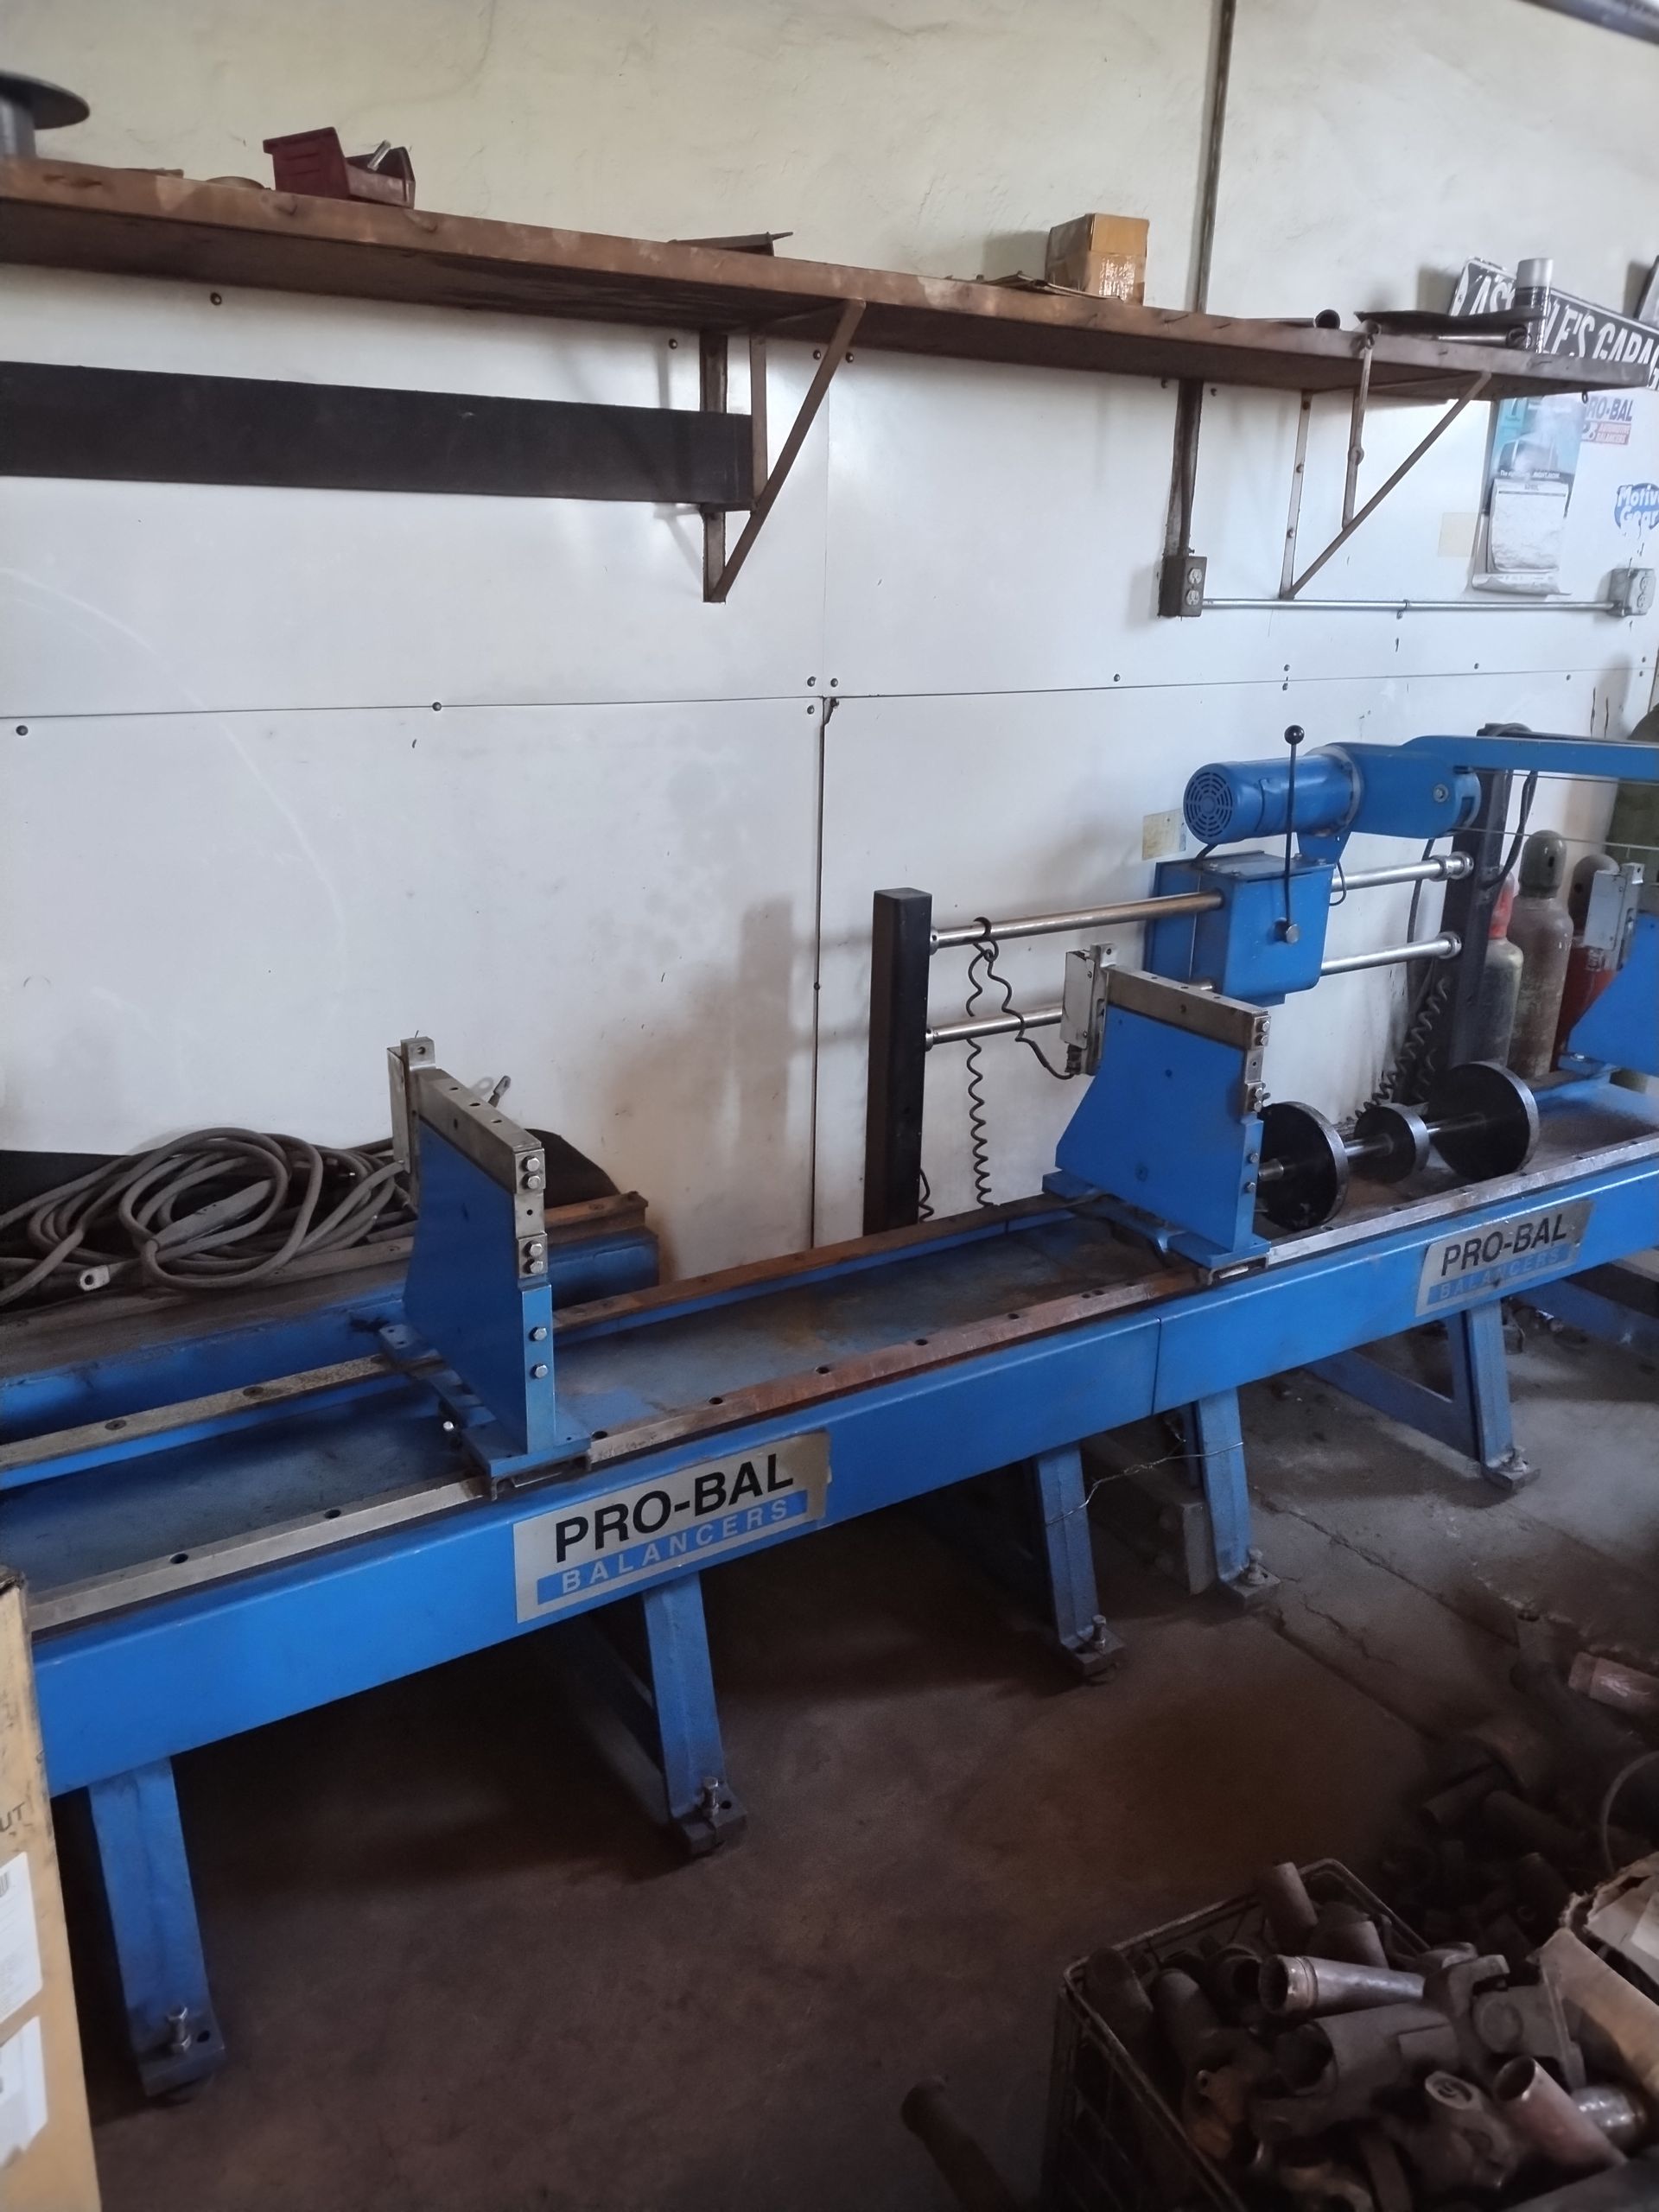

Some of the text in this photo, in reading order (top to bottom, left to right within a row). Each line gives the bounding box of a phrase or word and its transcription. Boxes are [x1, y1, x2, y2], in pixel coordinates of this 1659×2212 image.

[1586, 396, 1633, 422] RO-BAL
[1617, 484, 1659, 507] Motiv
[1441, 1214, 1567, 1276] PRO-BAL
[1440, 1250, 1560, 1298] BALANCERS
[556, 1453, 793, 1563] PRO-BAL
[563, 1500, 787, 1593] BALANCERS
